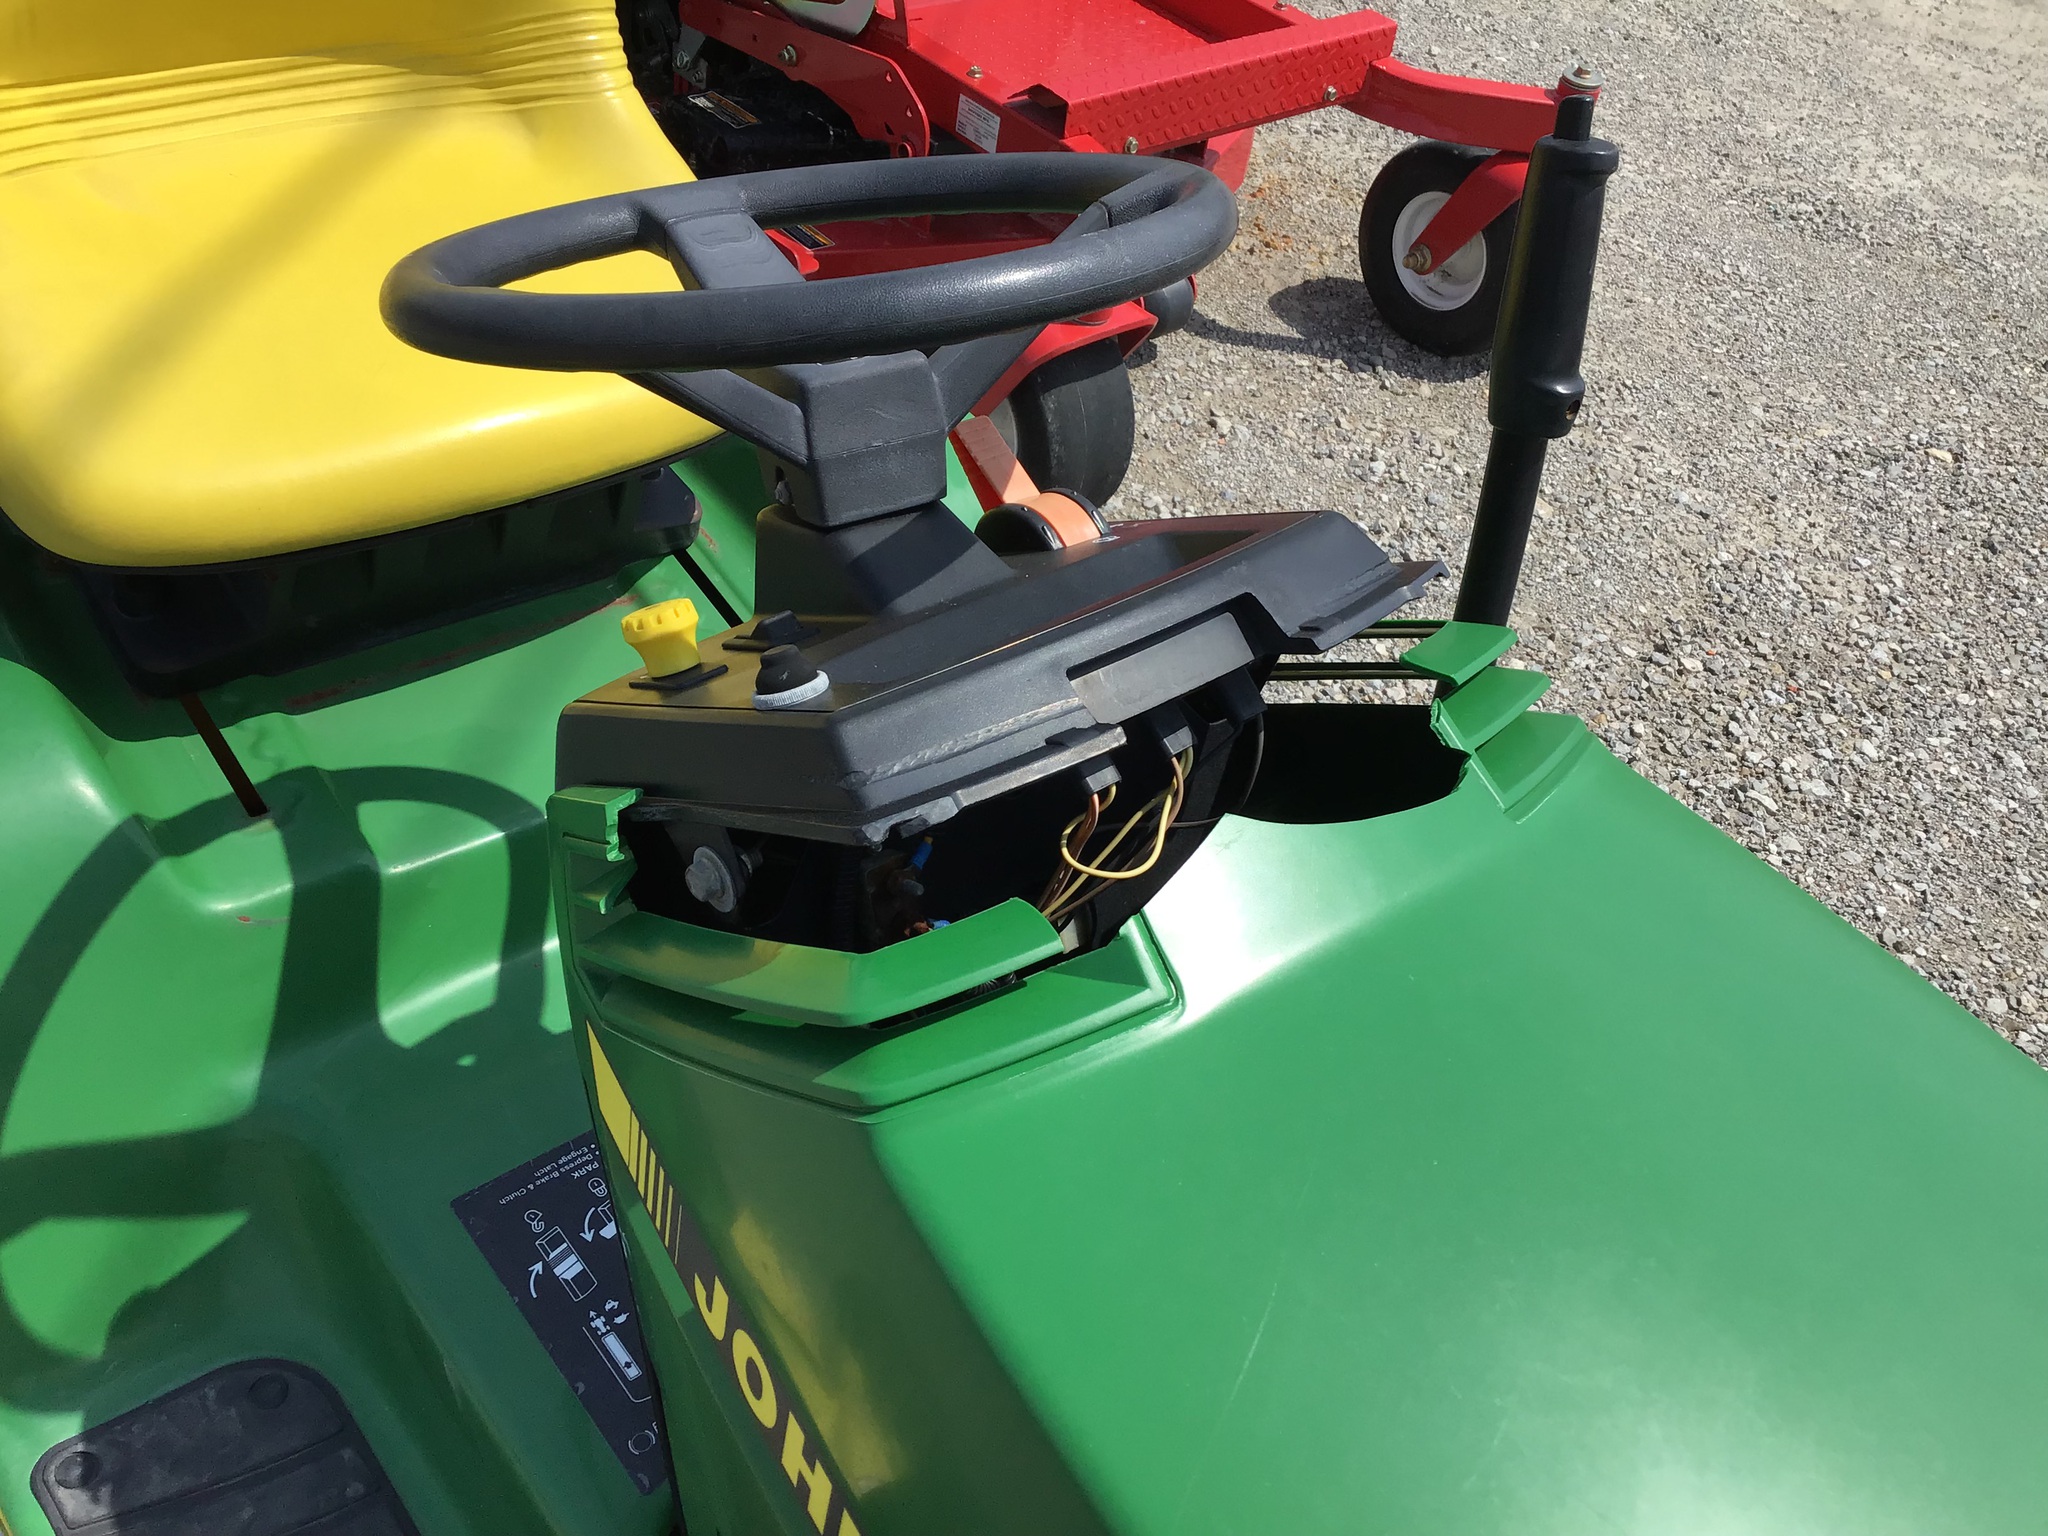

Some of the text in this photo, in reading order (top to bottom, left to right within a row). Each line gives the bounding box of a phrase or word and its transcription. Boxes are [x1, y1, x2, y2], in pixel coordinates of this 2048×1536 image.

[533, 1147, 589, 1177] Engage Latch
[560, 1153, 593, 1172] Depress
[571, 1161, 599, 1179] PARK
[535, 1173, 560, 1186] Brake
[499, 1188, 526, 1204] Clutch
